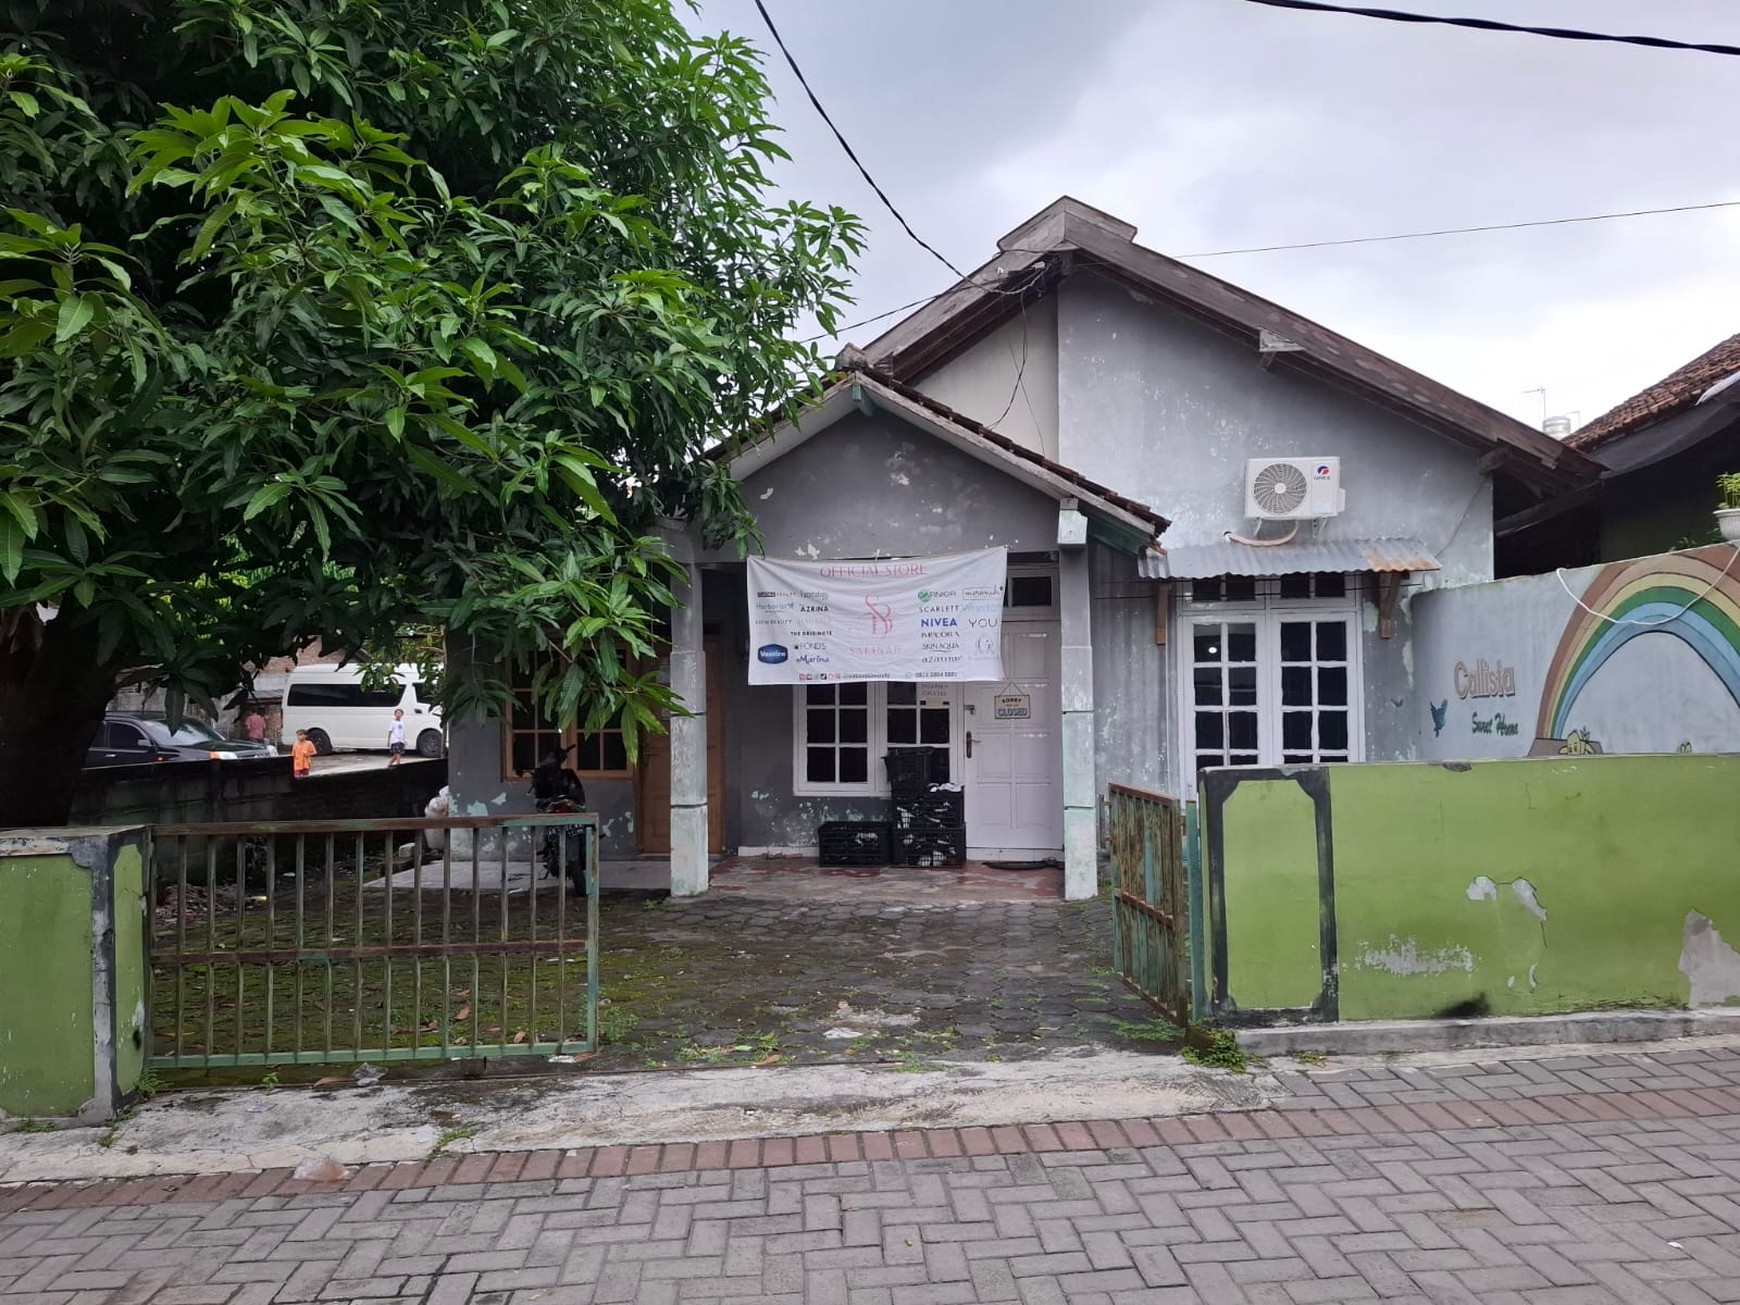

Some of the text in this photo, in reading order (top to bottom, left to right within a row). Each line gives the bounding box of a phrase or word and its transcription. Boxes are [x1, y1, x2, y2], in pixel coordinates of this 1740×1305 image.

[820, 562, 928, 578] OFFICIAL STORE
[800, 605, 829, 613] AZRINA
[918, 604, 959, 613] SCARLETT
[920, 617, 958, 628] NIVEA
[968, 618, 998, 628] YOU
[759, 650, 787, 659] Vaseline
[799, 654, 830, 664] Marina
[1453, 658, 1516, 700] Callista
[1471, 710, 1519, 737] Sweet Home
